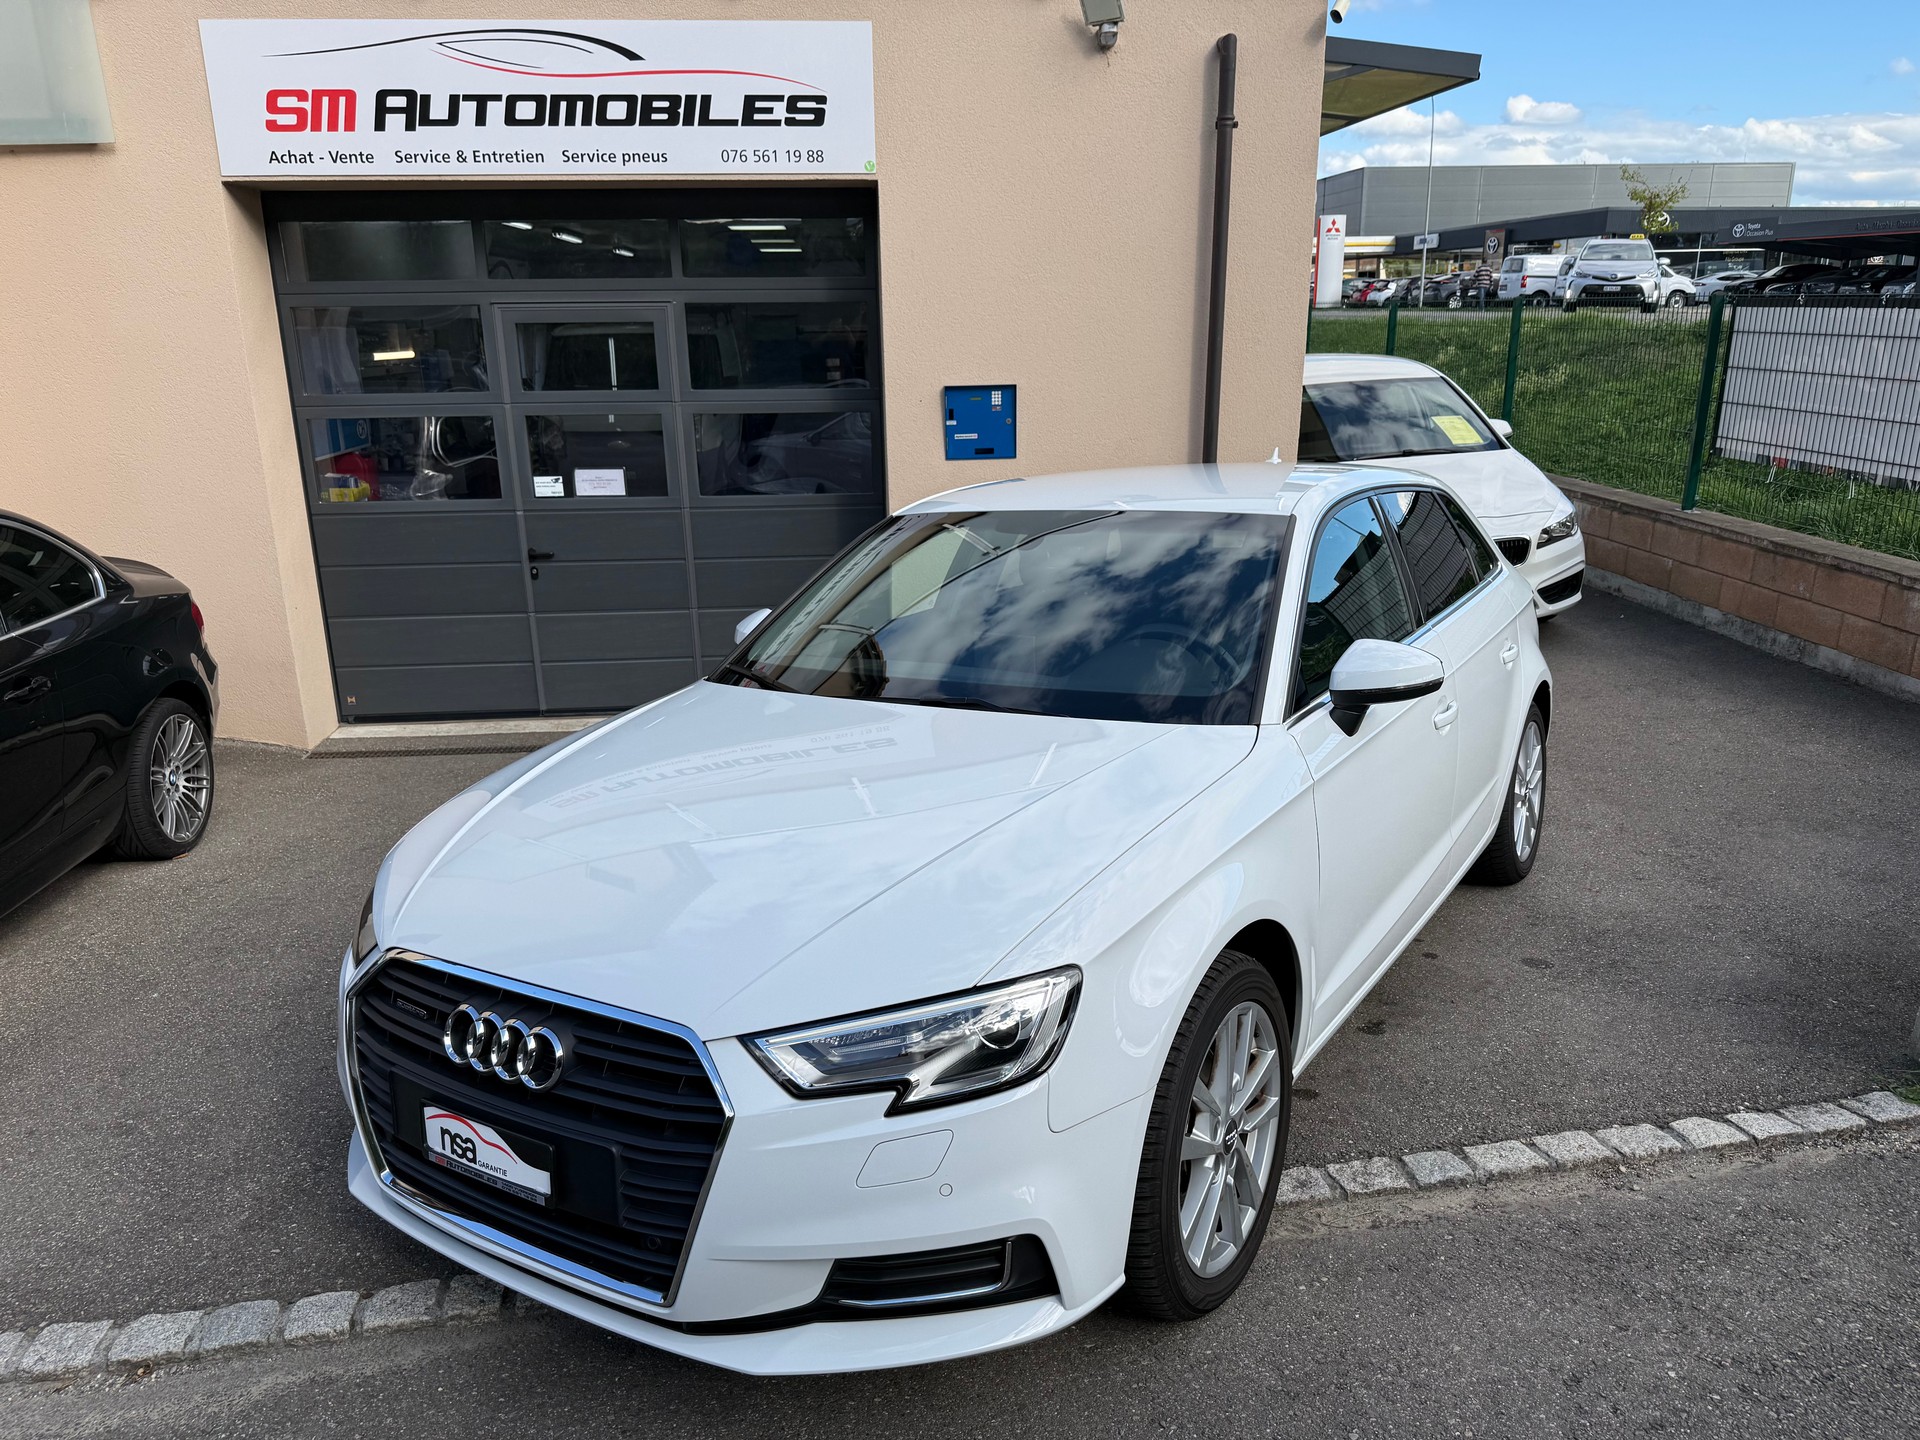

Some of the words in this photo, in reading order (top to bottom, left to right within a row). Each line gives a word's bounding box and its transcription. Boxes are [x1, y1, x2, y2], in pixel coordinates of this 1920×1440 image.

[266, 89, 356, 132] SM
[374, 89, 827, 132] AUTOMOBILES
[269, 150, 315, 164] Achat
[328, 151, 375, 164] Vente
[394, 150, 451, 164] Service
[456, 150, 468, 164] &
[473, 149, 545, 164] Entretien
[562, 149, 617, 163] Service
[622, 152, 668, 167] pneus
[721, 150, 748, 163] 076
[754, 150, 778, 163] 561
[785, 150, 802, 163] 19
[807, 150, 825, 163] 88
[440, 1126, 478, 1165] nsa
[478, 1160, 508, 1177] GARANTIE
